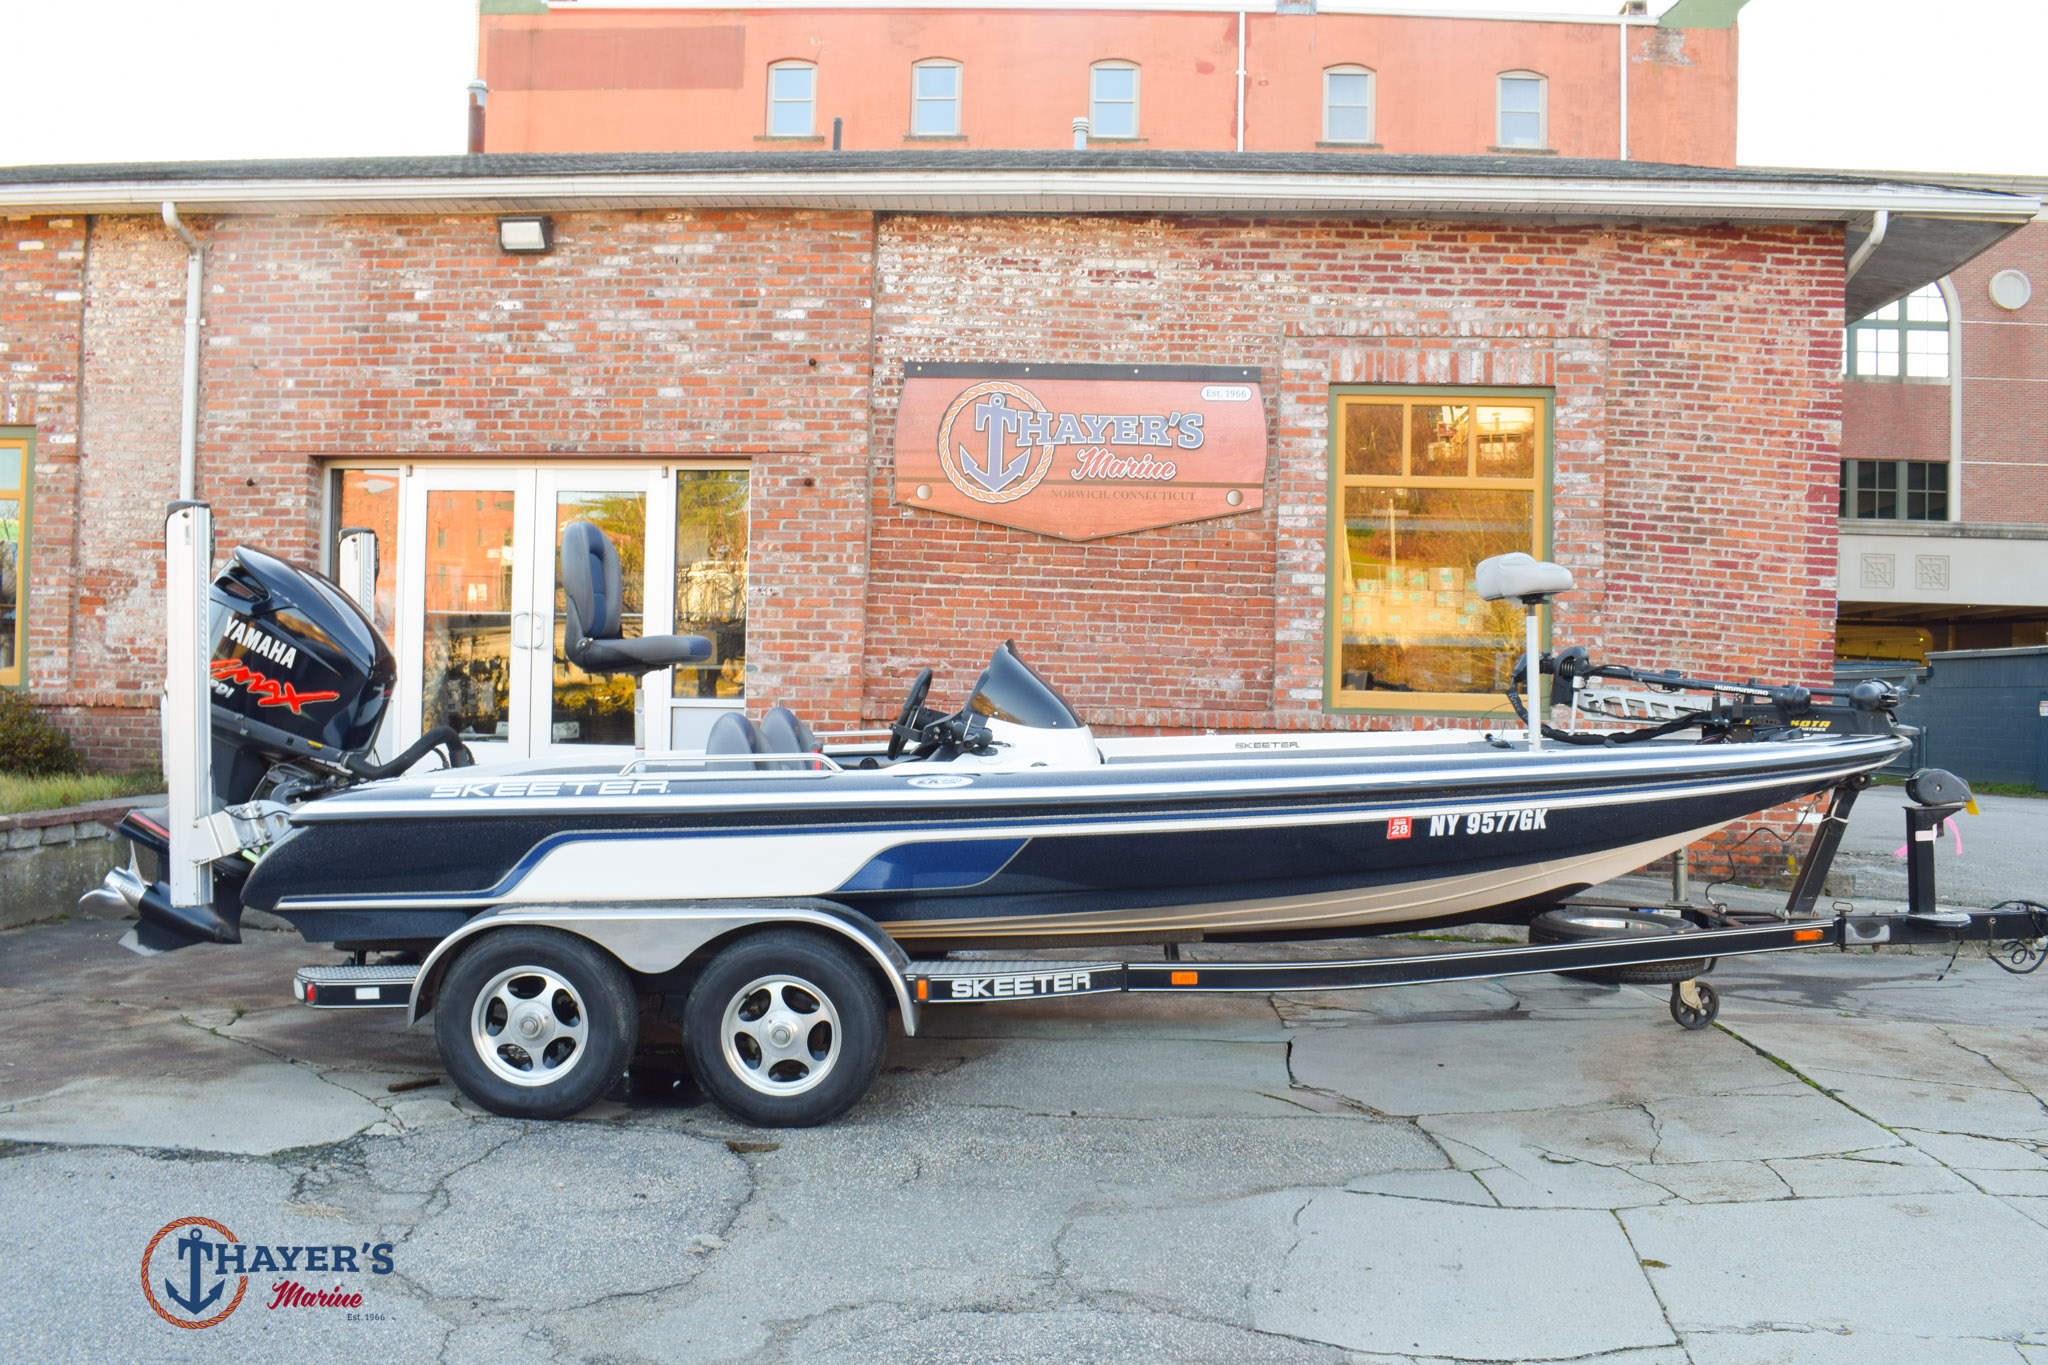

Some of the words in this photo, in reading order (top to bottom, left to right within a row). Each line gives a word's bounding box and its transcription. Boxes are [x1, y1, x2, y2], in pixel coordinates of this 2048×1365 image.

[1206, 389, 1223, 398] Est.
[1225, 389, 1247, 398] 1966
[1071, 446, 1177, 481] Marine
[1112, 490, 1197, 501] CONNECTICUT
[223, 616, 297, 669] YAMAHA
[1235, 741, 1300, 749] SKEETER
[430, 780, 669, 798] SKEETER
[1391, 825, 1409, 835] 28
[1429, 814, 1461, 837] NY
[1466, 808, 1549, 835] 9577GK
[951, 972, 1092, 999] SKEETER
